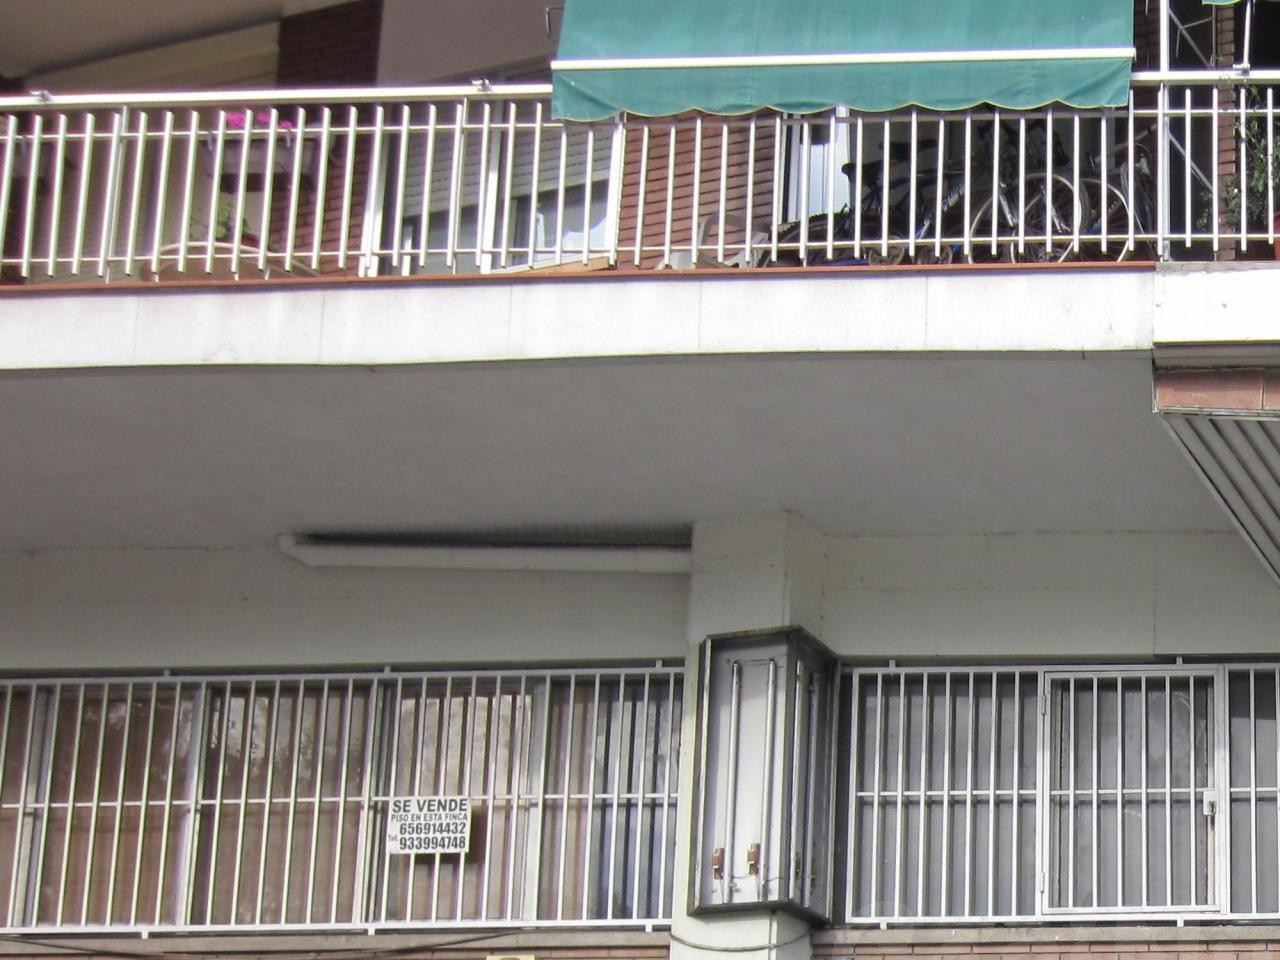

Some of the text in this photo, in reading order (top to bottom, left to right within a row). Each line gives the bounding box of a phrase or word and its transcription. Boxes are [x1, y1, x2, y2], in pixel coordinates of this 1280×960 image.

[392, 798, 468, 813] SE VENDE
[391, 814, 409, 822] PISO
[423, 813, 442, 821] ESTA
[445, 812, 468, 821] FINCA
[399, 822, 467, 835] 656914432
[399, 836, 466, 850] 933994748
